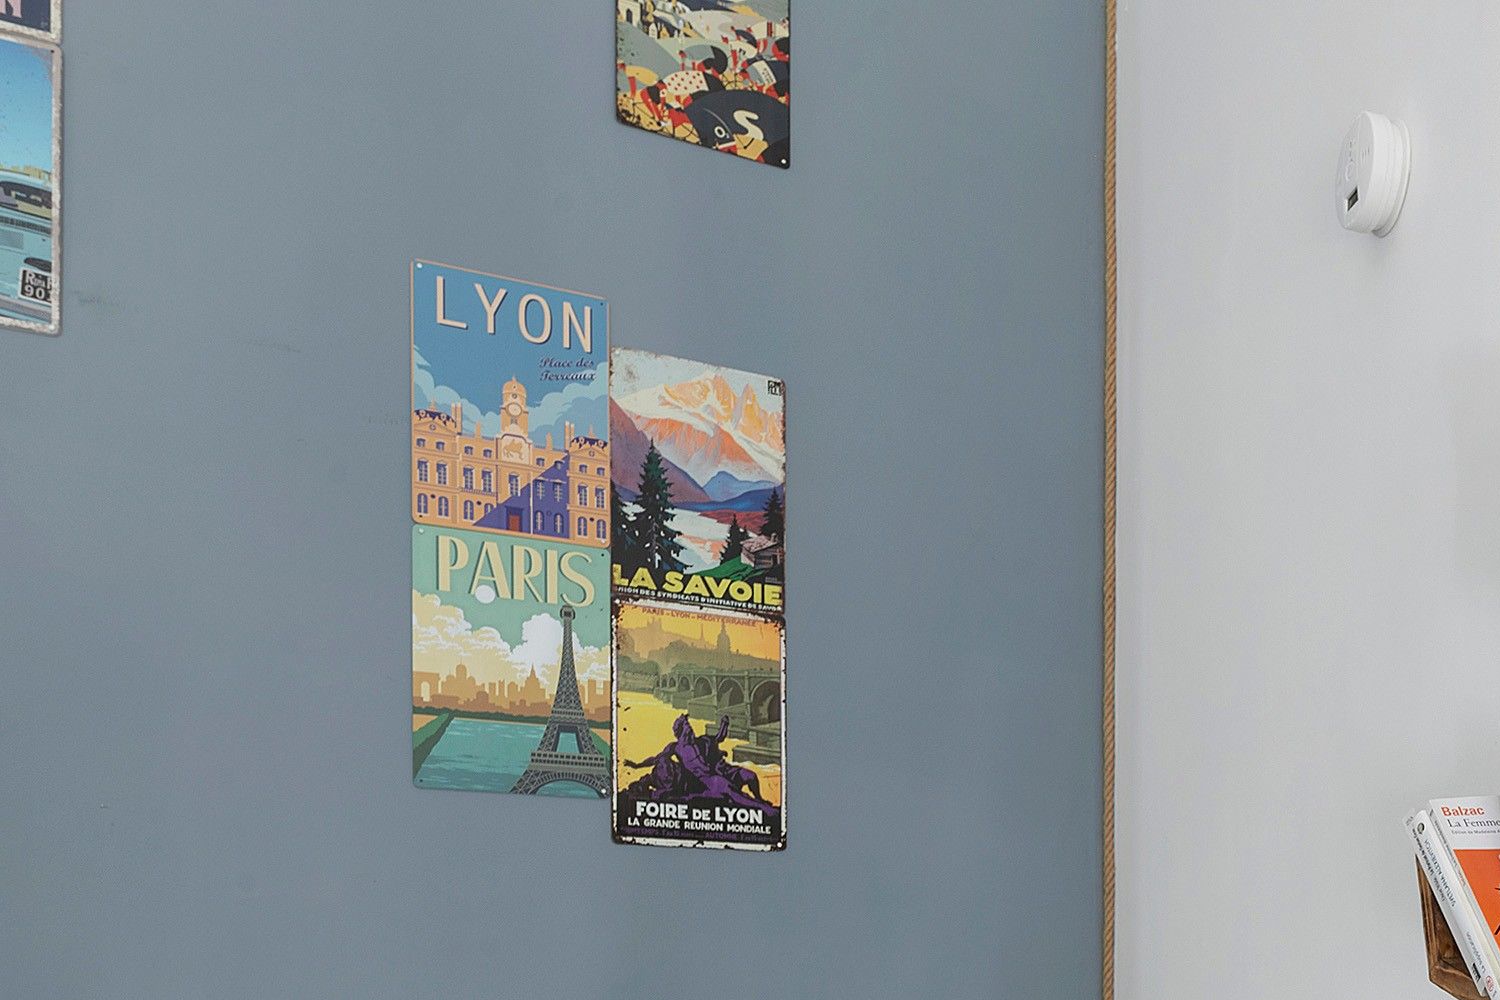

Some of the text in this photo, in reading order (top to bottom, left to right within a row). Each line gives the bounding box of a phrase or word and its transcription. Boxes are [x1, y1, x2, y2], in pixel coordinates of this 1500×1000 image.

[435, 275, 593, 354] LYON
[539, 357, 572, 369] Place
[435, 535, 596, 609] PARIS
[612, 563, 783, 606] LA SAVOIE
[636, 801, 763, 824] FOIRE DE LYON
[1441, 806, 1485, 816] Balzac
[627, 817, 640, 826] LA
[644, 819, 680, 829] GRANDE
[727, 825, 771, 834] MONDIALE
[1447, 819, 1461, 827] La
